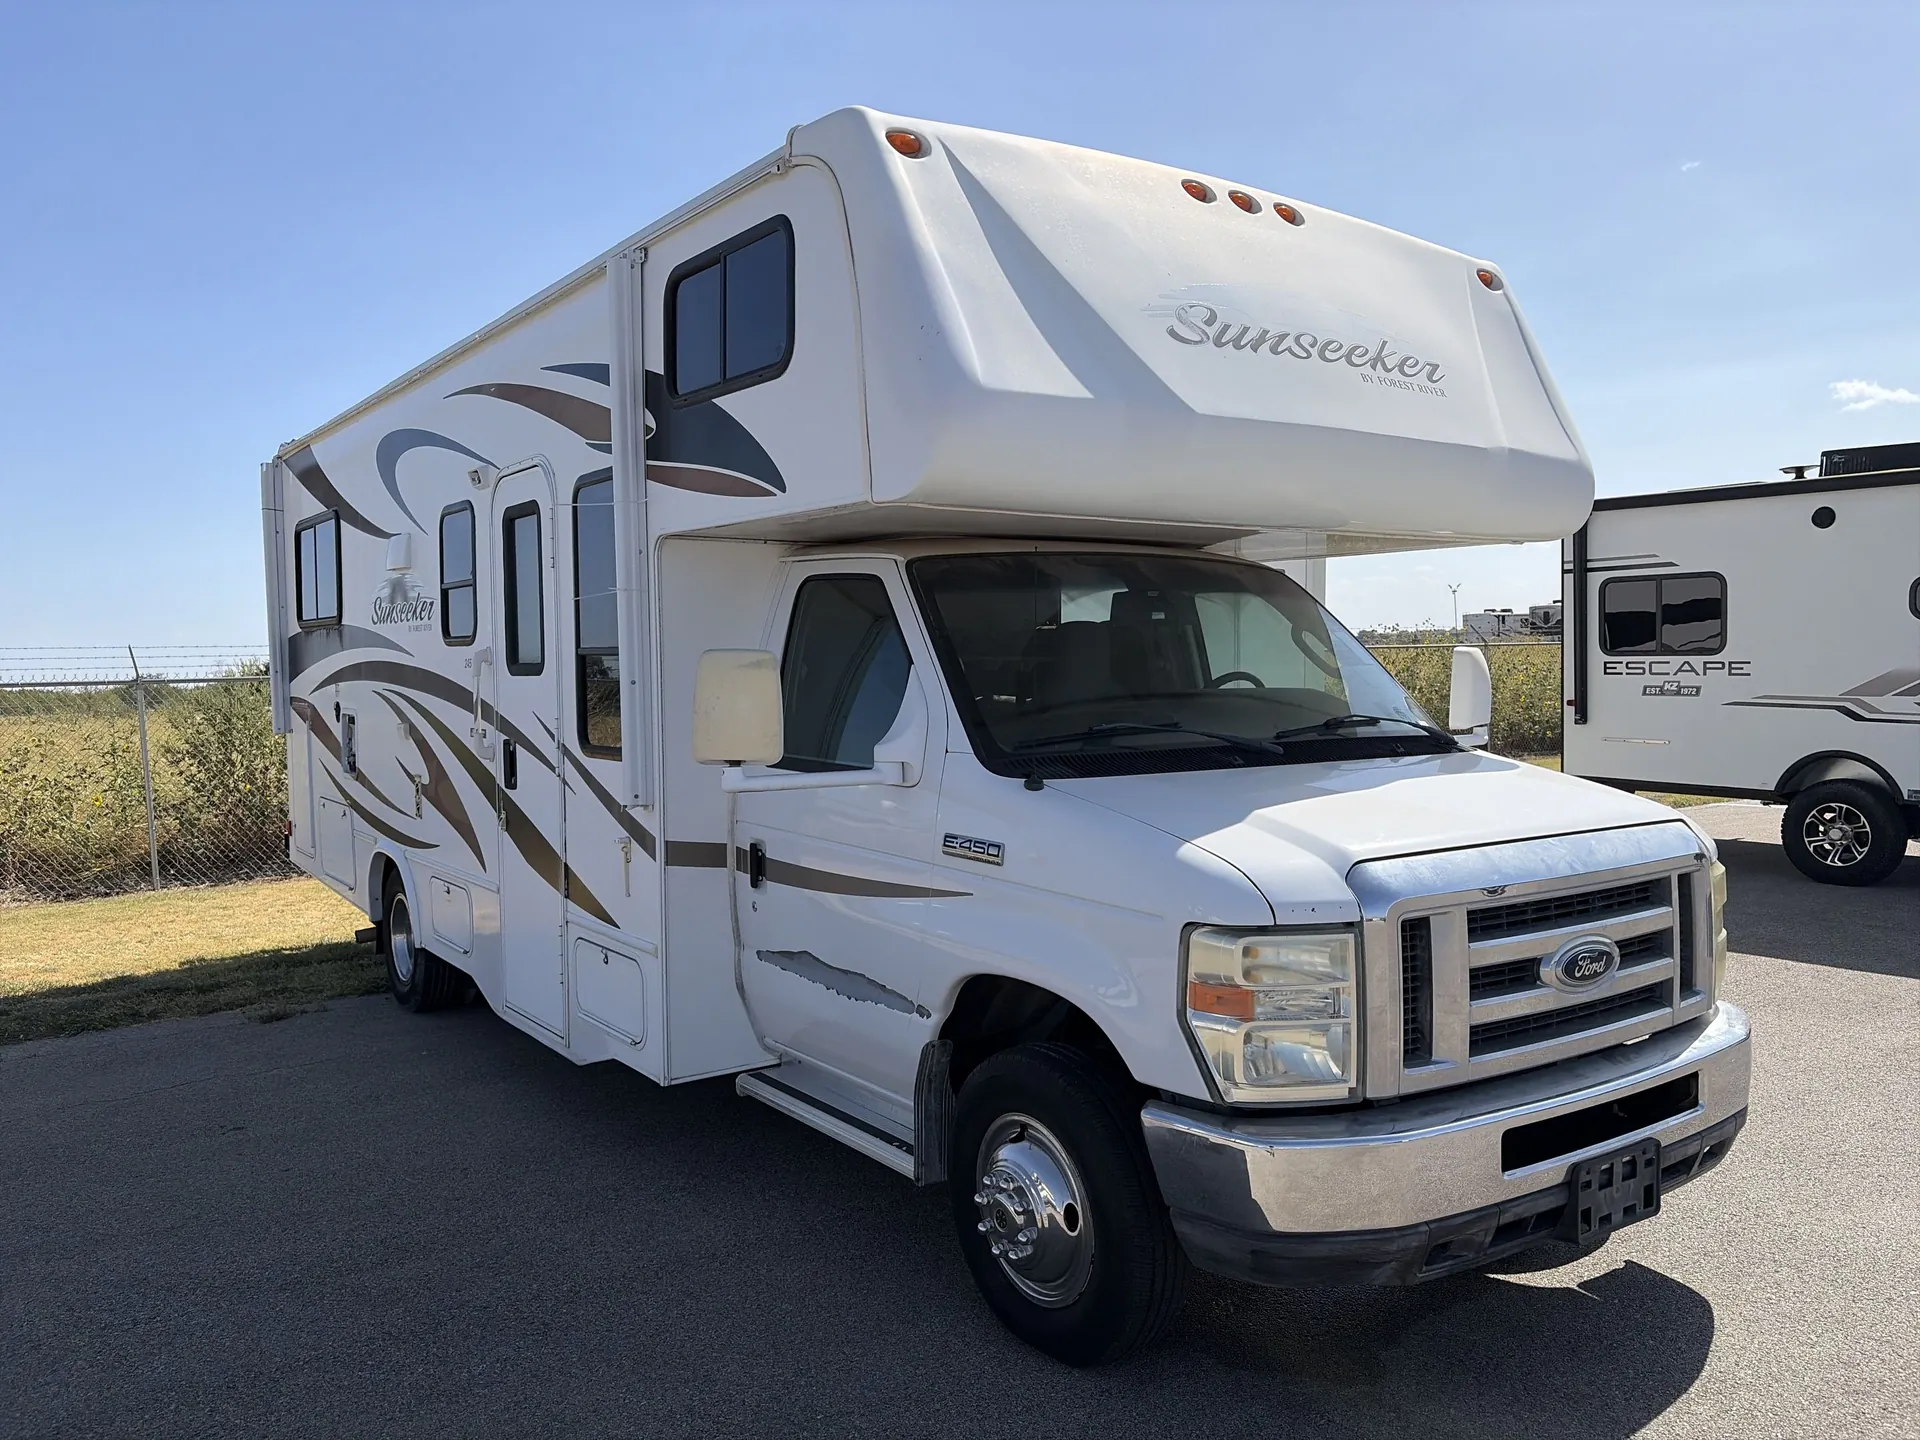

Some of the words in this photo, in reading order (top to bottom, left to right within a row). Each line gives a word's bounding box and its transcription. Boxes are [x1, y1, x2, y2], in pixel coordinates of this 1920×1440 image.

[1166, 301, 1447, 384] Sunseeker
[1360, 372, 1374, 384] BY
[1377, 376, 1415, 392] FOREST
[1417, 383, 1448, 399] RIVER
[371, 592, 436, 626] Sunseeker
[1603, 660, 1752, 677] ESCAPE
[1646, 687, 1661, 695] EST.
[1680, 687, 1697, 695] 1972
[1574, 951, 1607, 978] Ford
